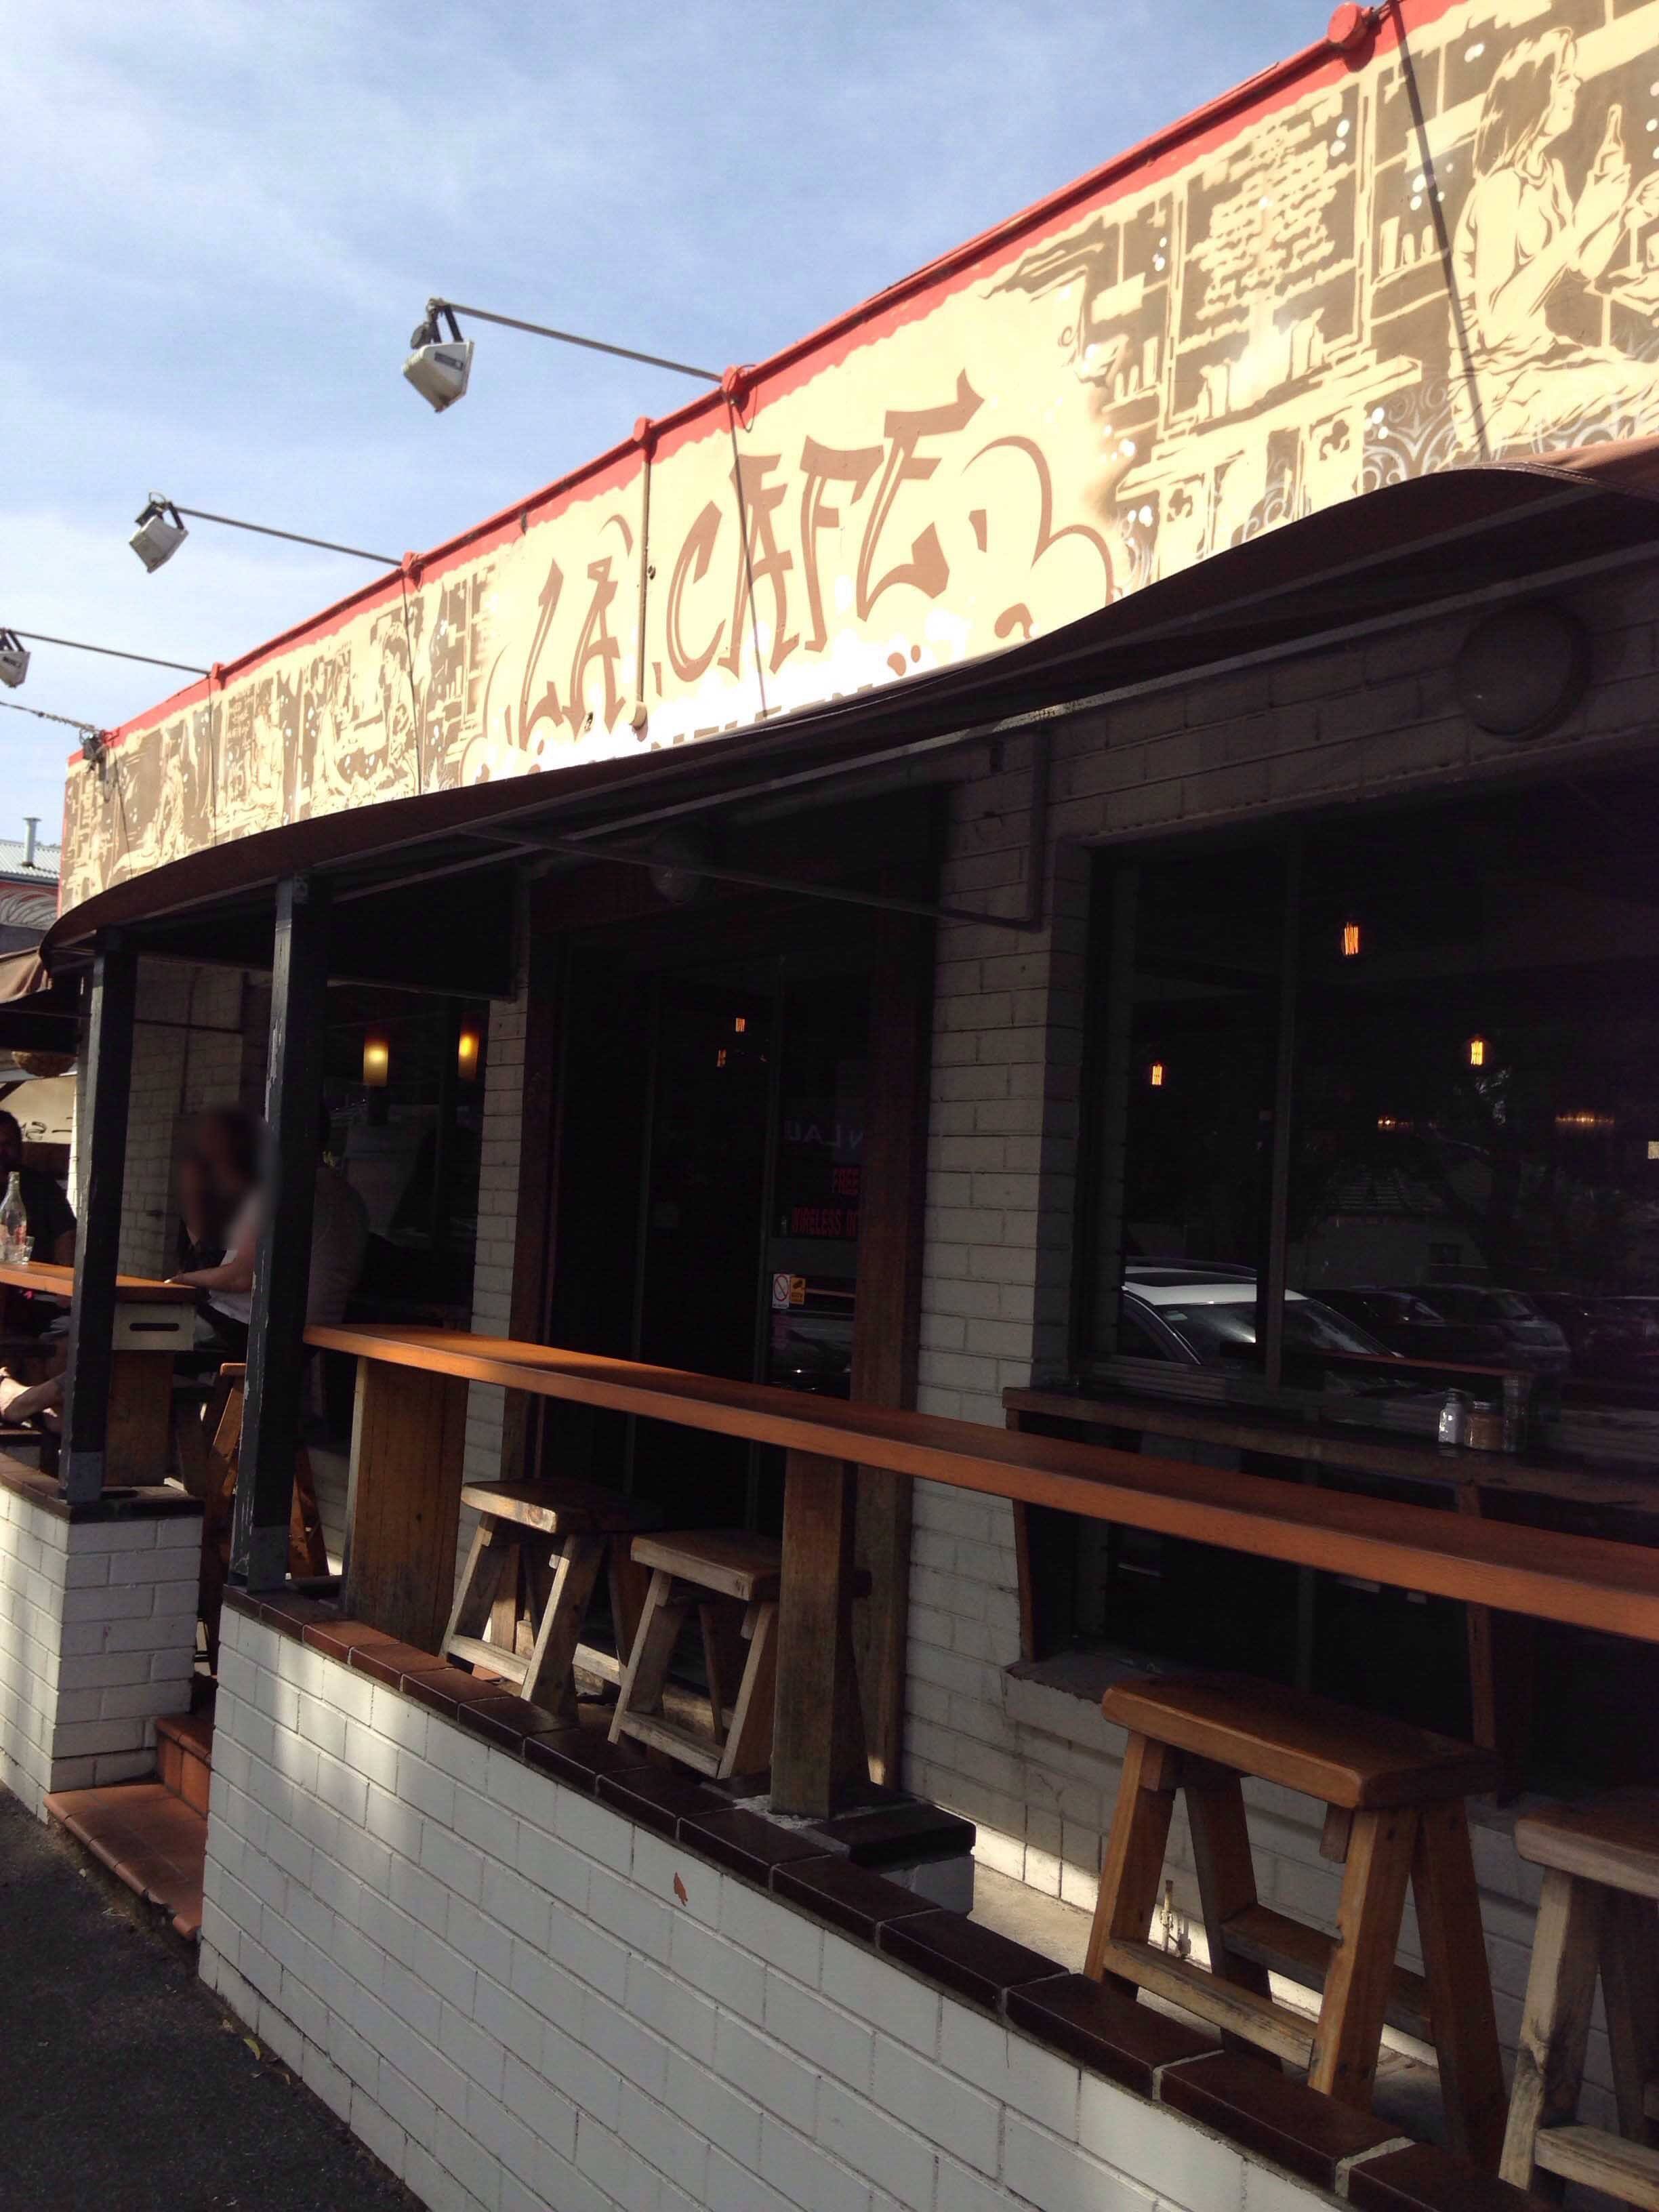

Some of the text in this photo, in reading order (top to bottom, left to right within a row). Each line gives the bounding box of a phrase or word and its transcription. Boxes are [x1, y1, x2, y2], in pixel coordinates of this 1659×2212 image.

[519, 368, 985, 752] LA CAFE
[834, 1167, 858, 1197] FREE
[792, 1206, 842, 1237] WIRELESS
